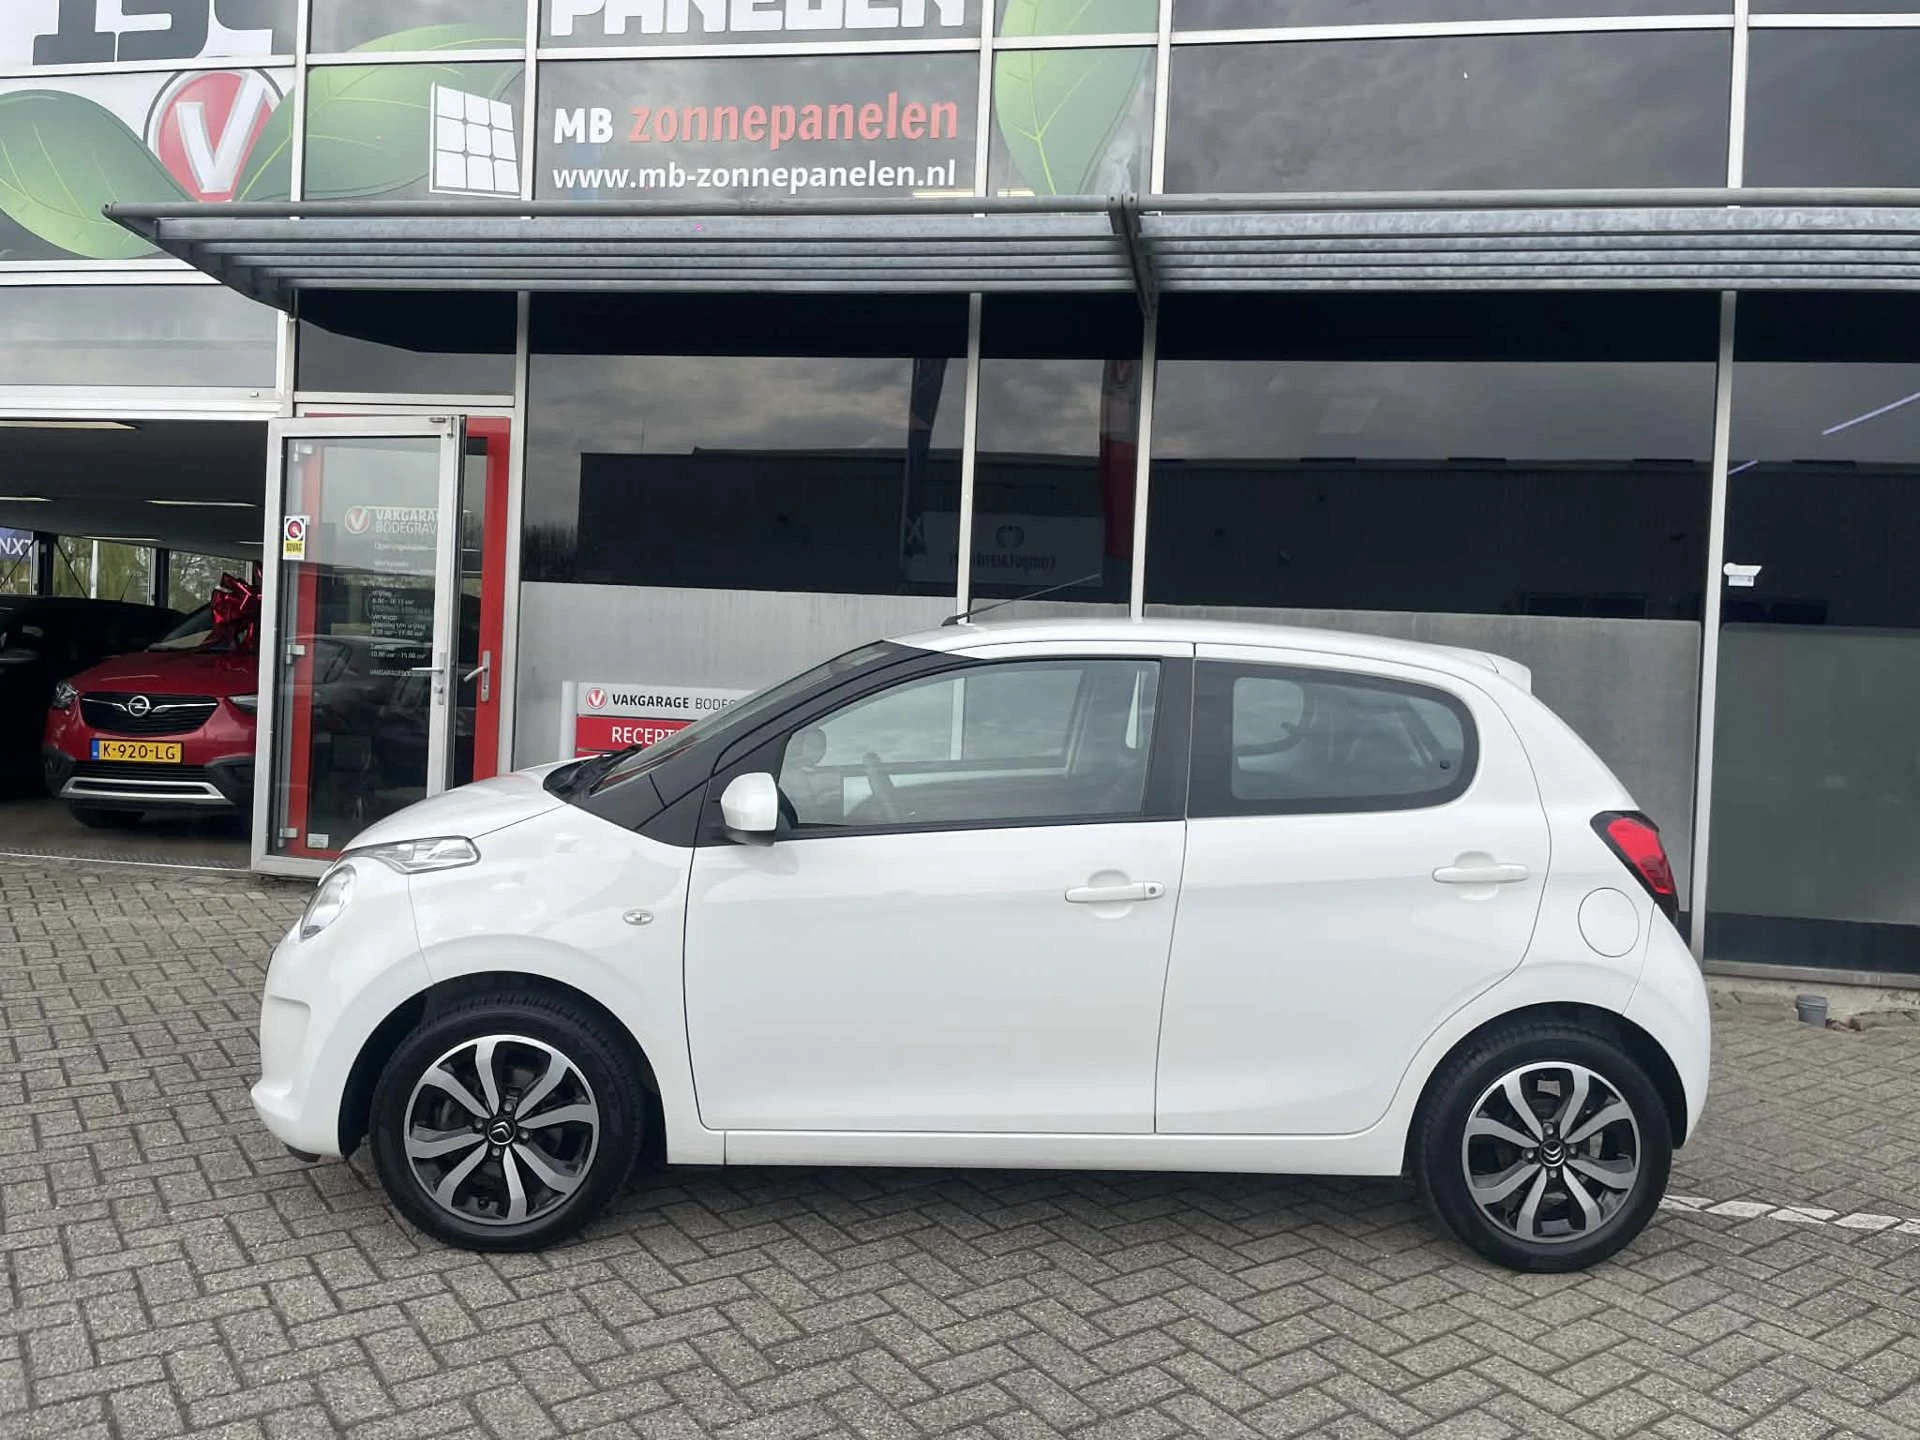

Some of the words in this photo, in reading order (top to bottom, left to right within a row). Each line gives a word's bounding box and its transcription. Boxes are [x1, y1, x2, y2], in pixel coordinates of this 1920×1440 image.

[553, 107, 614, 144] MB
[628, 90, 958, 150] zonnepanelen
[552, 159, 956, 194] www.mb-zonnepanelen.nl
[612, 694, 689, 709] VAKGARAGE
[103, 743, 175, 759] K-920-LG
